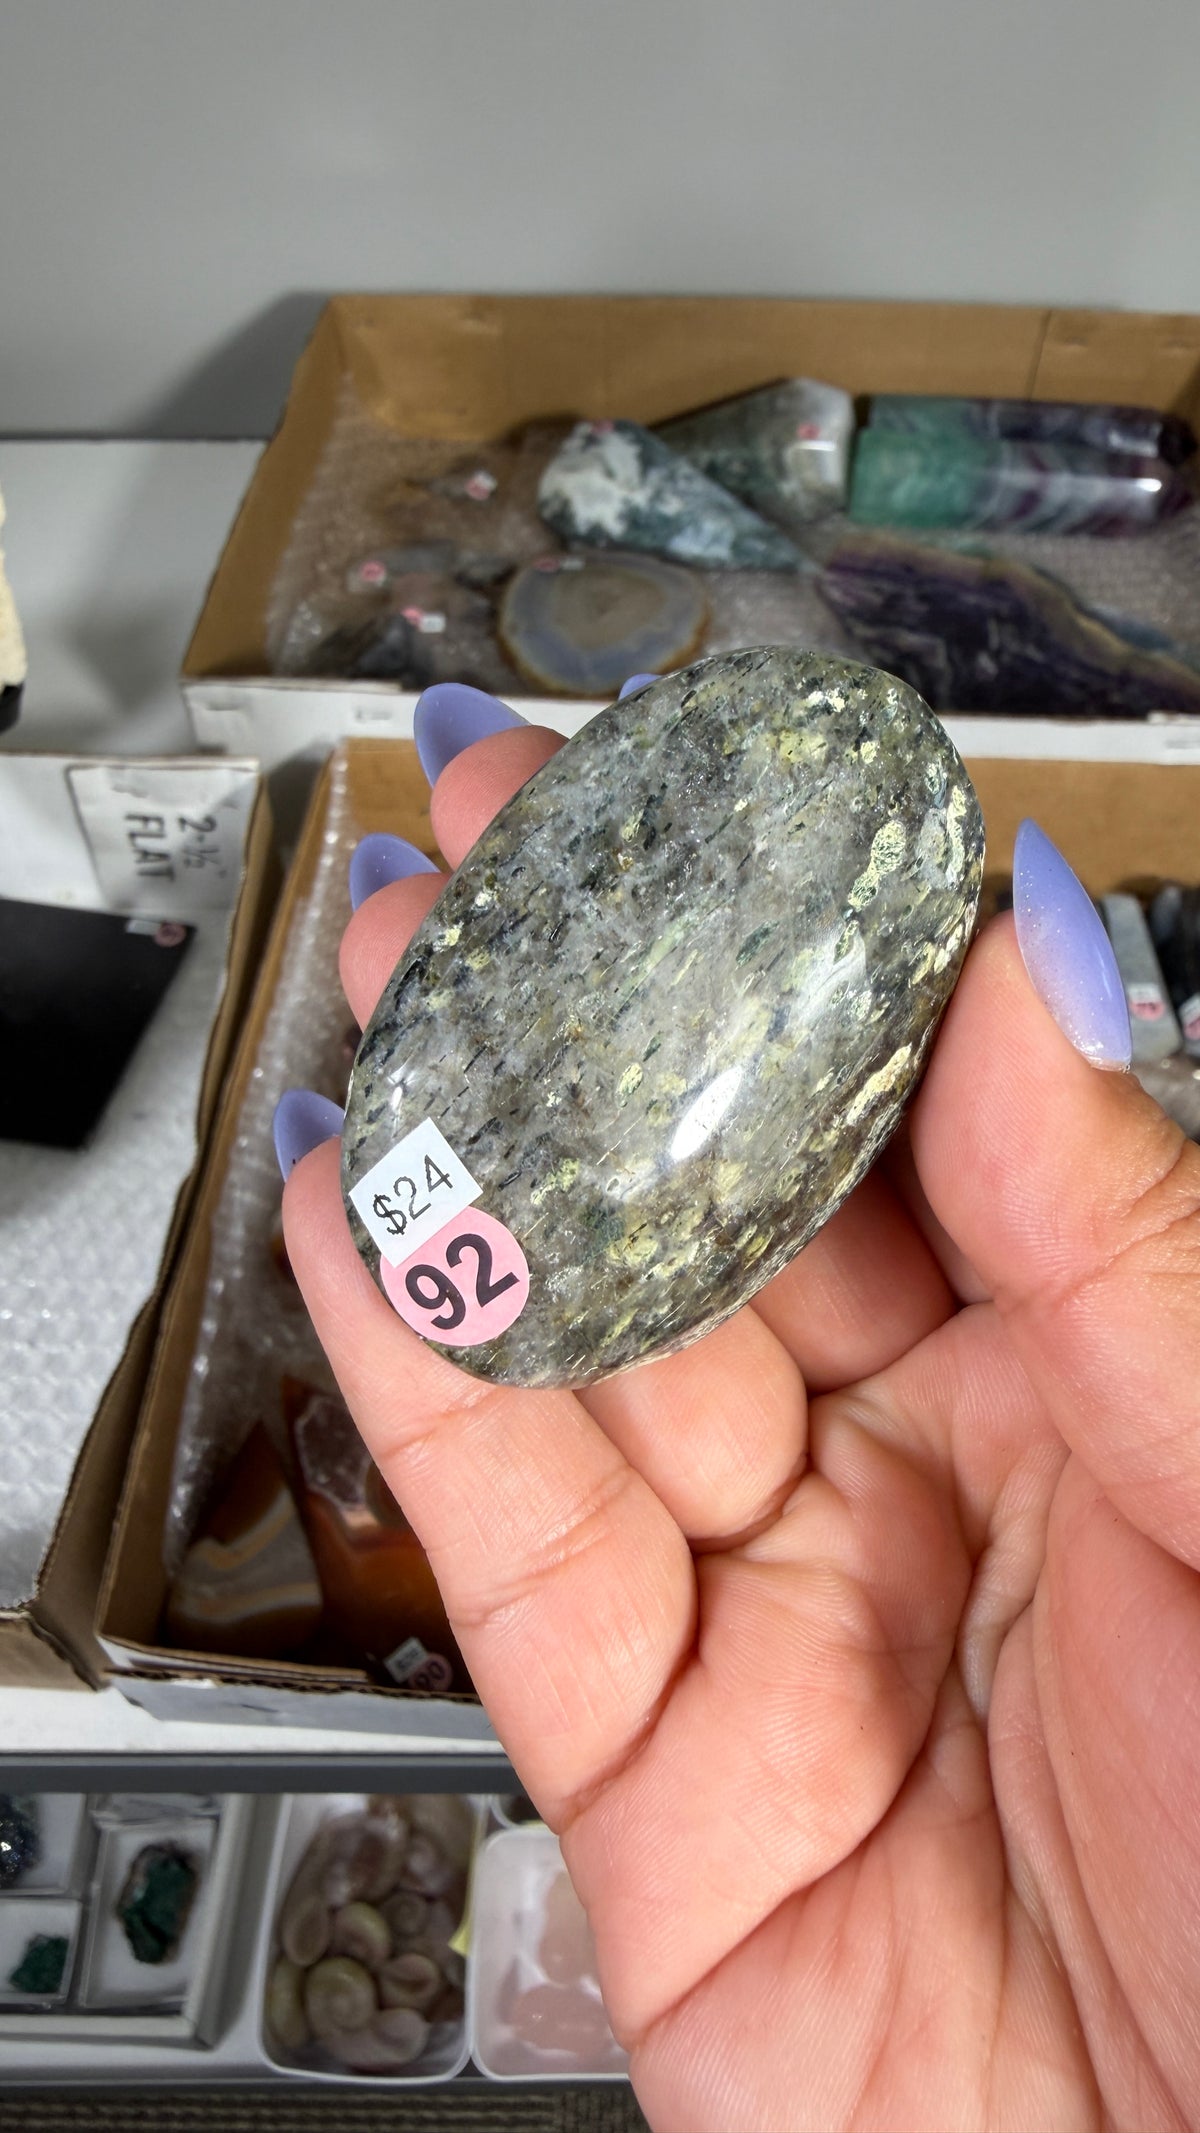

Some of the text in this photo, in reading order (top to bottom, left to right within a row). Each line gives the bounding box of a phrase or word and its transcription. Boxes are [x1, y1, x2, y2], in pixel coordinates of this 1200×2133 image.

[124, 813, 176, 882] FLAT
[372, 1154, 454, 1235] $24
[405, 1233, 520, 1330] 92
